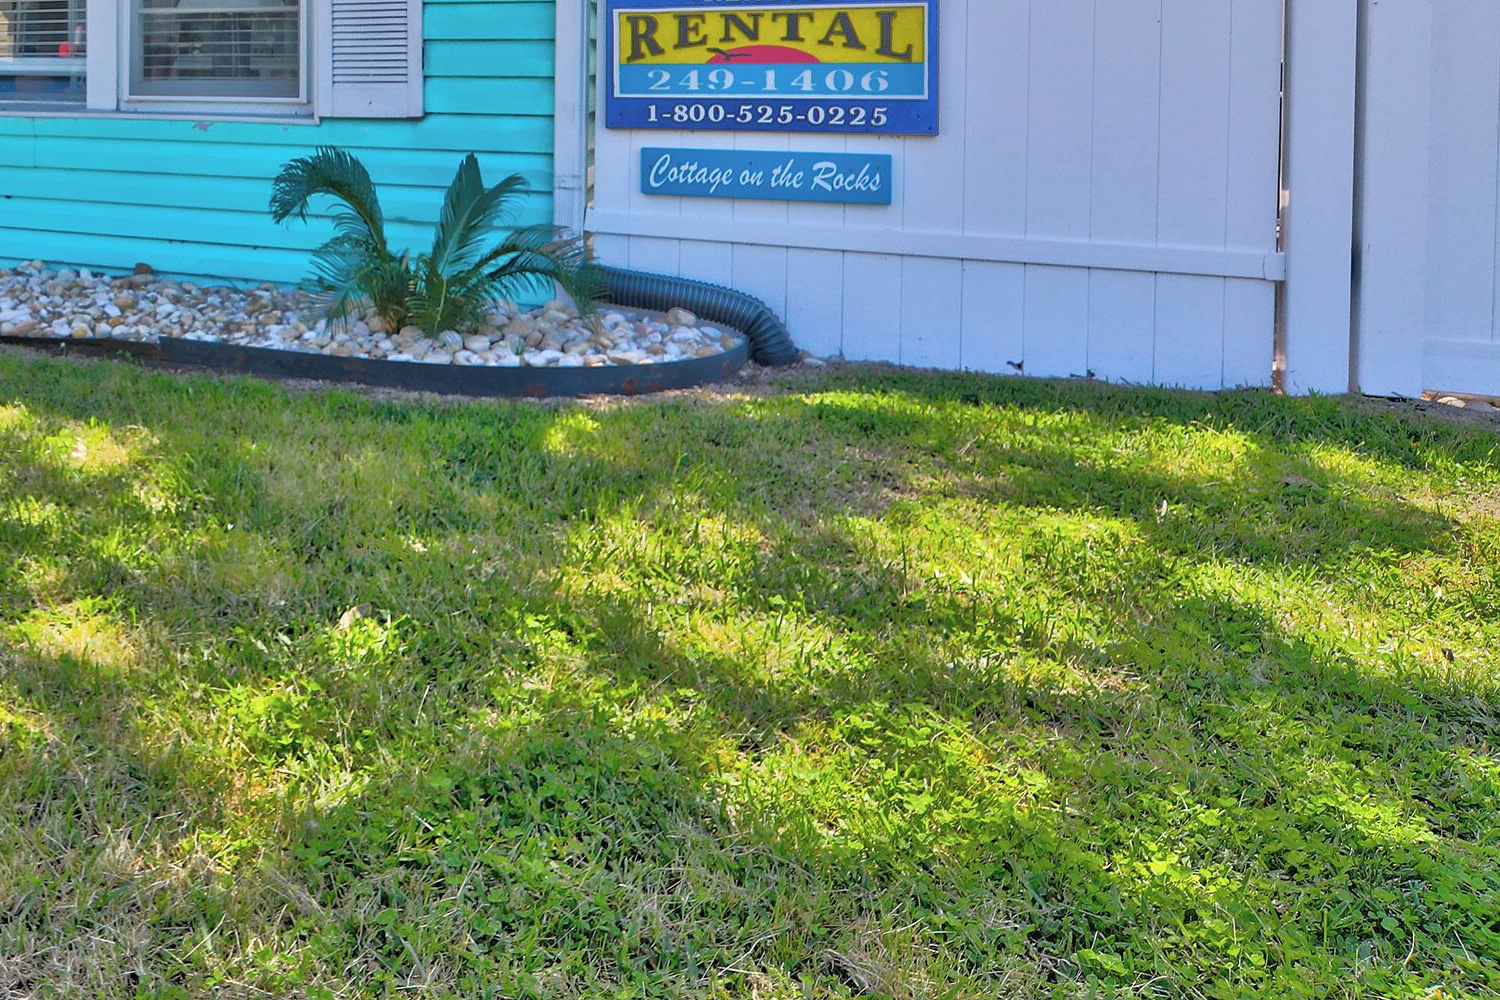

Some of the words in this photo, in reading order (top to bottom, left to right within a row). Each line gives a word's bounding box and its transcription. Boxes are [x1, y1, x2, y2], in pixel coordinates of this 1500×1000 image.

[626, 10, 914, 63] RENTAL
[646, 68, 891, 93] 249-1406
[646, 103, 889, 127] 1-800-525-0225
[649, 153, 733, 194] Cottage
[739, 168, 764, 187] on
[770, 158, 804, 189] the
[811, 161, 883, 193] Rocks
